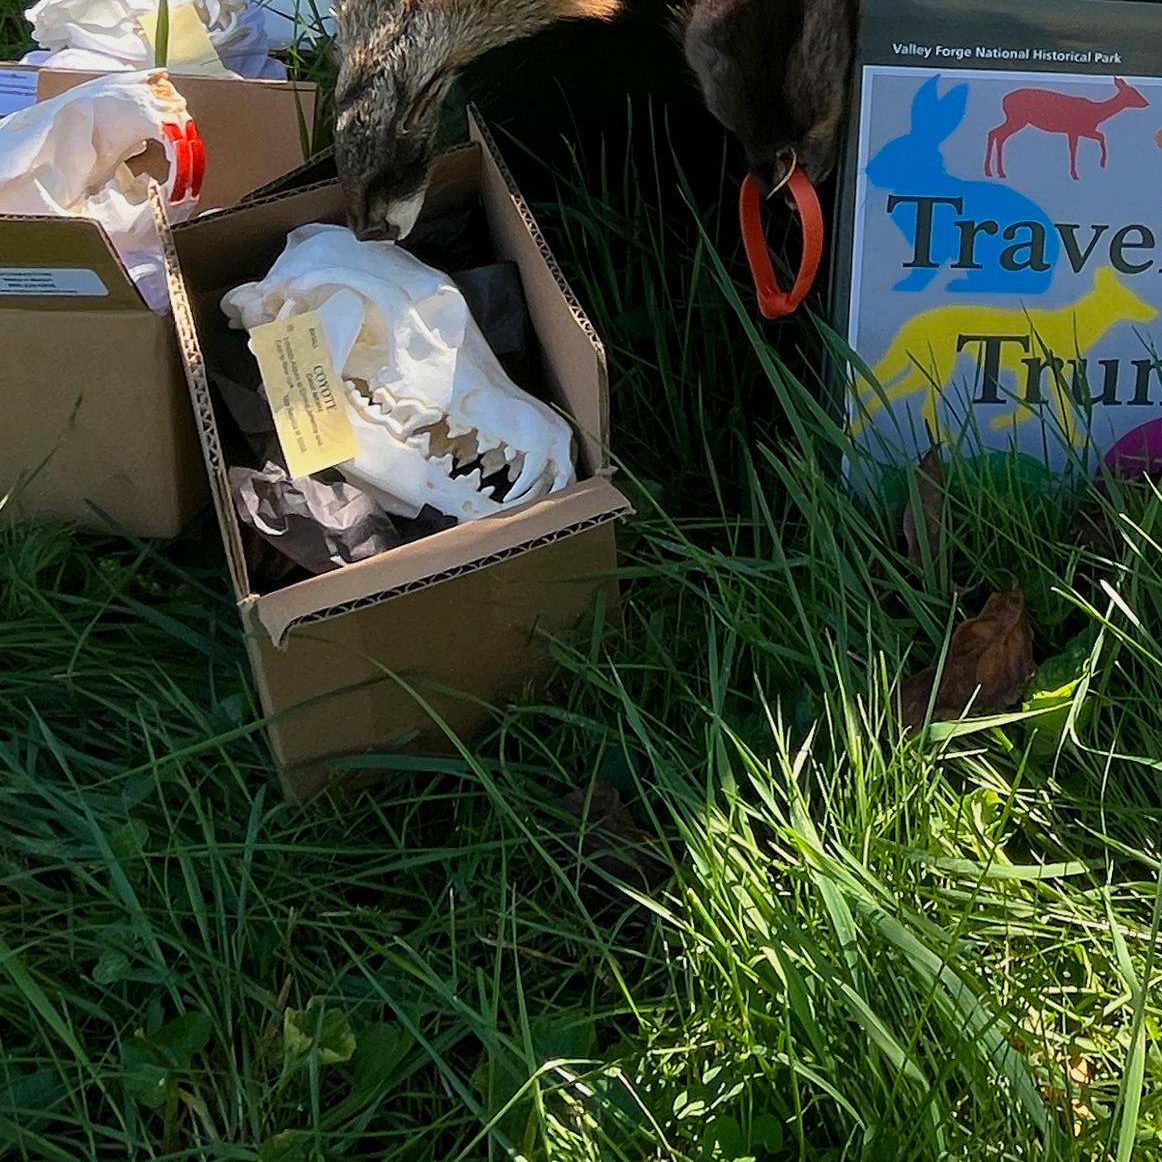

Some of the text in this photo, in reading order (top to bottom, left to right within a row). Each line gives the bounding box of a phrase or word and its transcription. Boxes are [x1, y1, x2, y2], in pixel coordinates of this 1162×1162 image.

[892, 43, 1122, 64] Valley Forge National Historical Park
[313, 365, 337, 411] COYOTE
